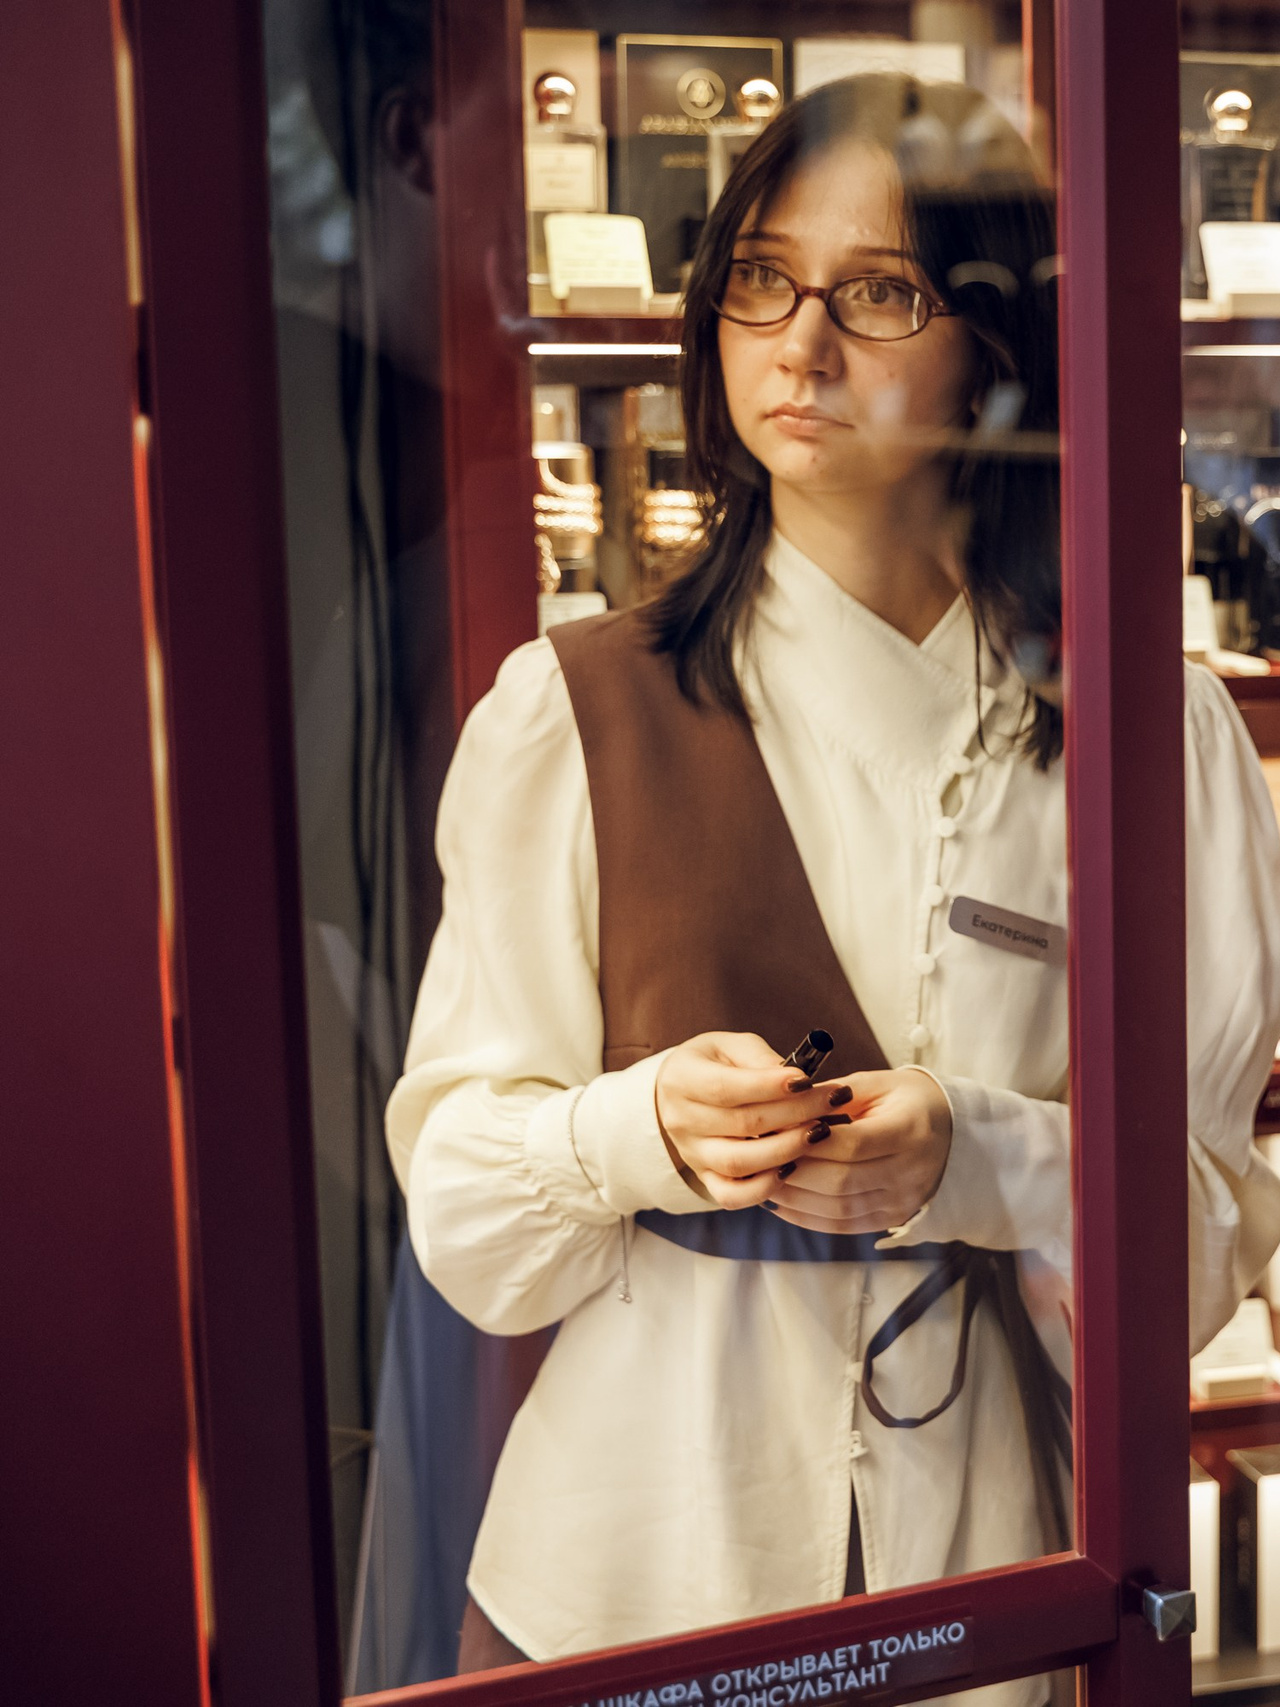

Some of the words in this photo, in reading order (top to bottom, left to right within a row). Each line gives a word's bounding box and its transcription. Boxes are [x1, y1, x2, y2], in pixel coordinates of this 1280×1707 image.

[971, 913, 1049, 949] Екатерина
[711, 1644, 861, 1694] ОТКРЫВАЕТ
[869, 1621, 966, 1658] ТОЛЬКО
